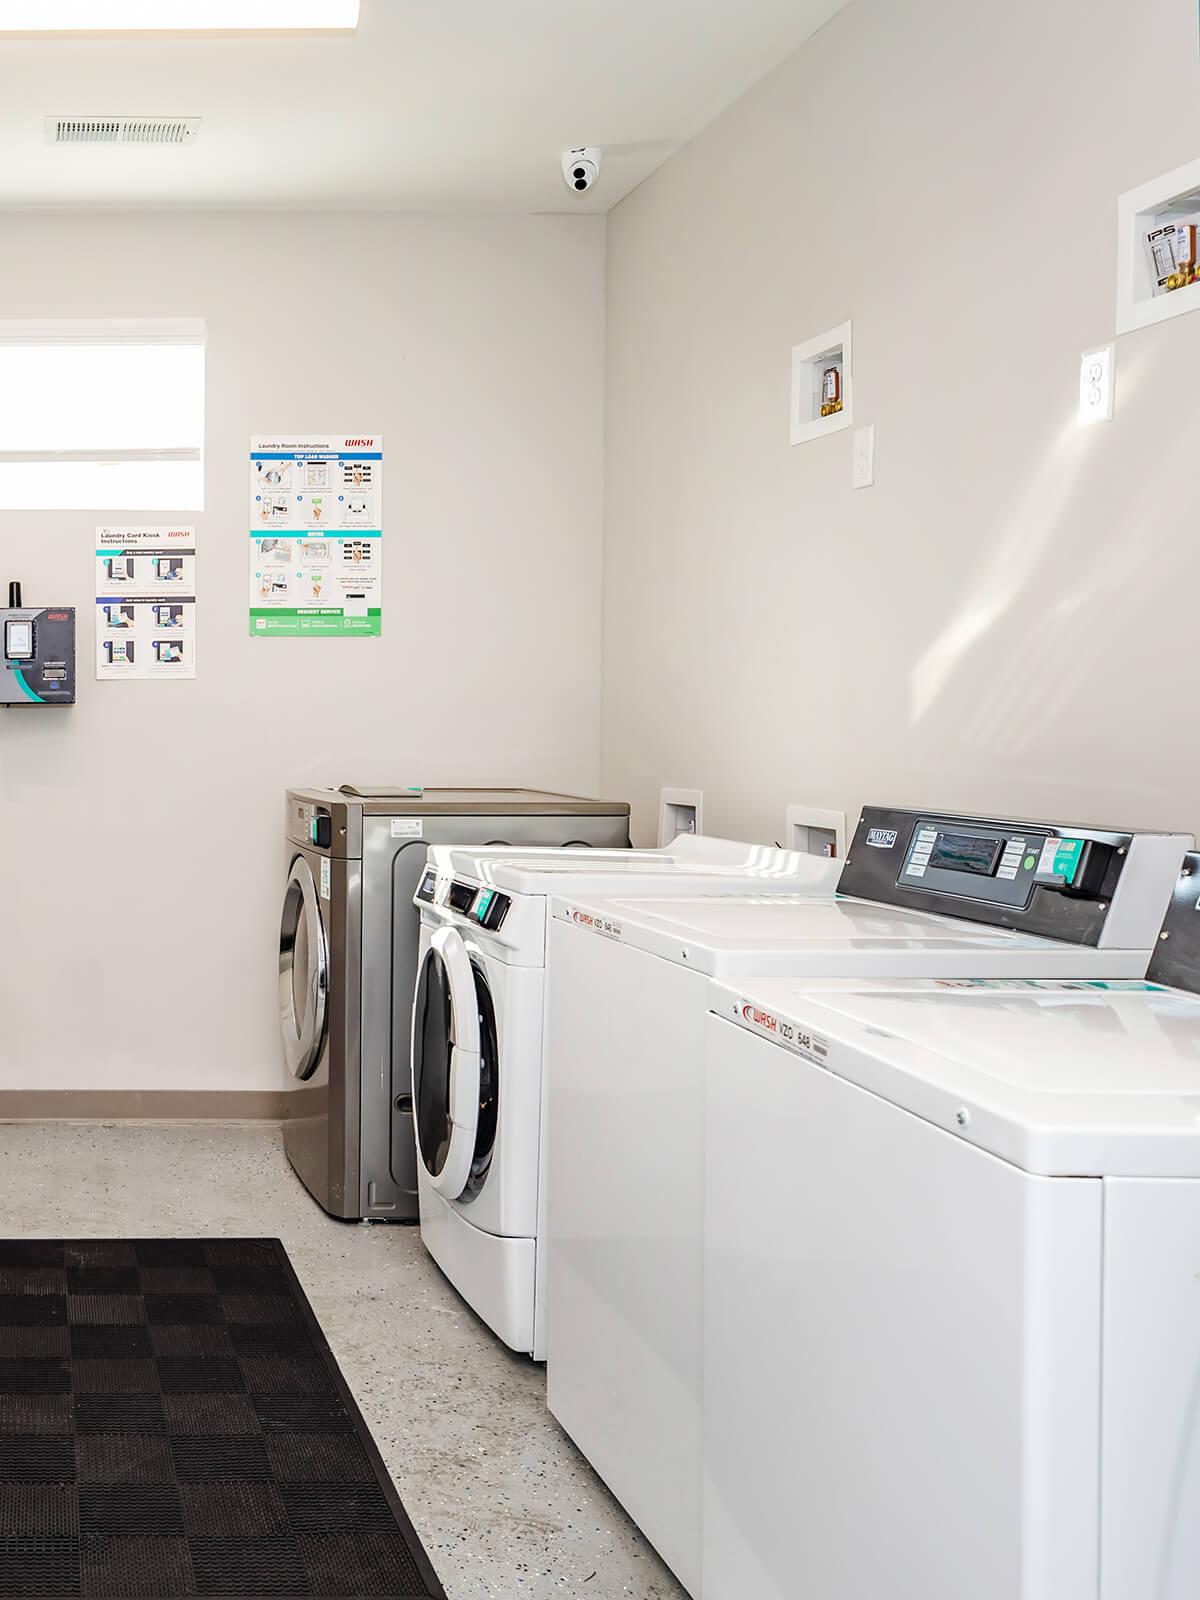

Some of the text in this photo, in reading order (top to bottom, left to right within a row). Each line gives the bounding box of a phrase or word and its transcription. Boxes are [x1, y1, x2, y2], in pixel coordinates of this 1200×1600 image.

[1147, 225, 1176, 242] IPS
[344, 439, 374, 447] WASH
[869, 830, 895, 842] MAYTAG
[1026, 847, 1040, 855] START
[753, 1007, 777, 1032] WASH
